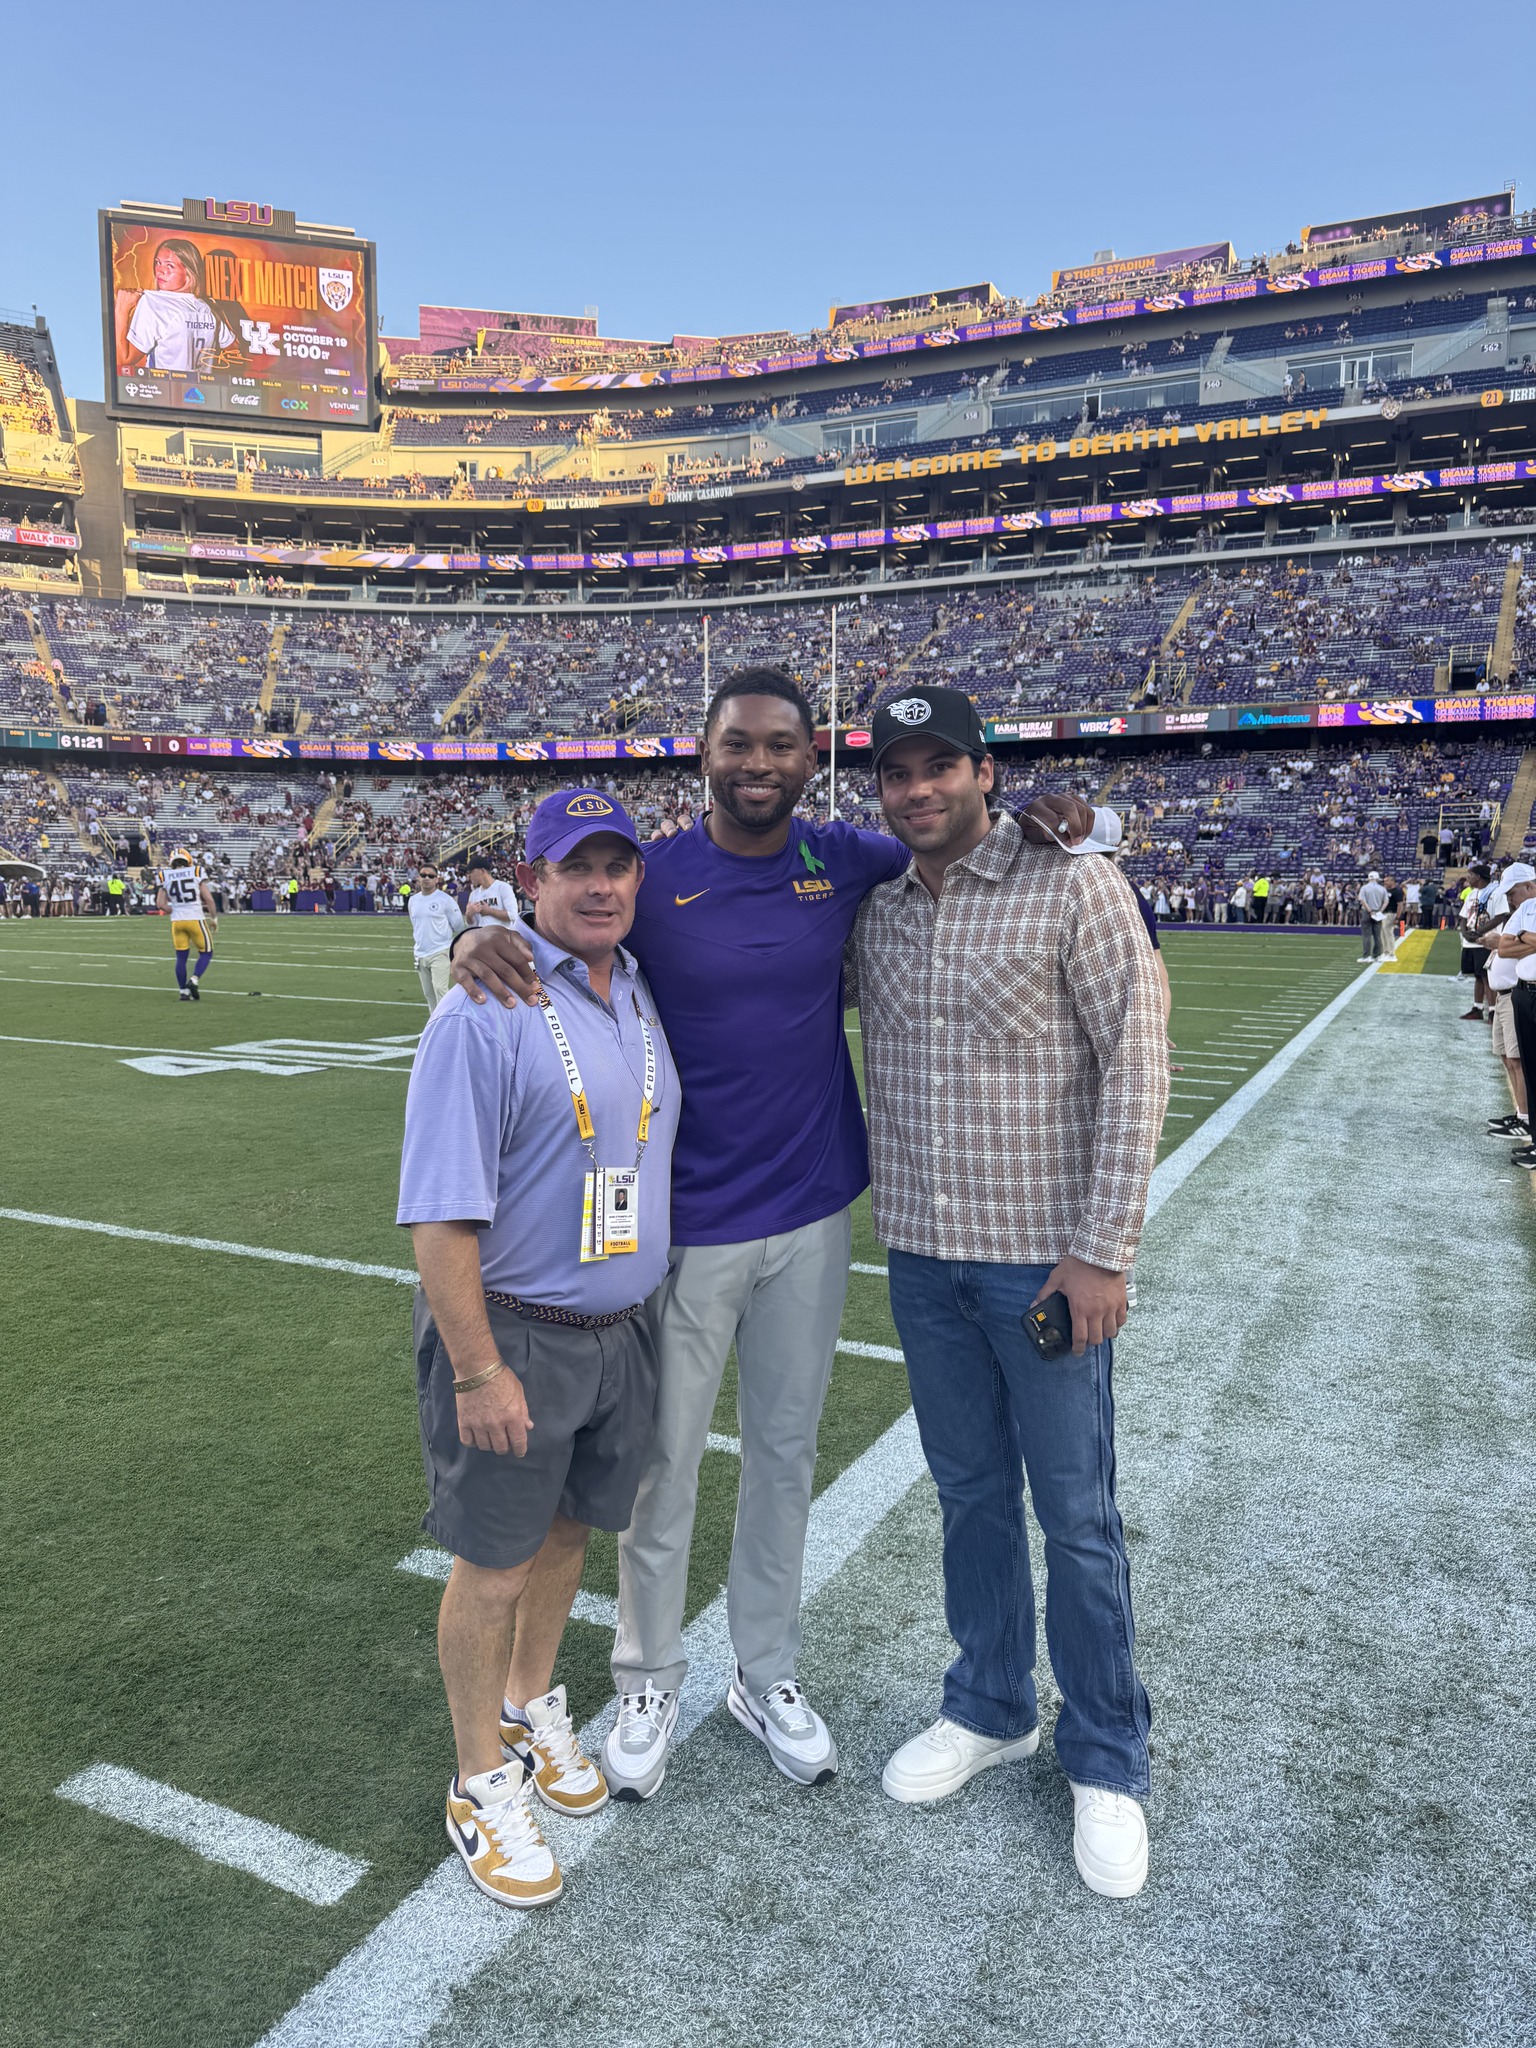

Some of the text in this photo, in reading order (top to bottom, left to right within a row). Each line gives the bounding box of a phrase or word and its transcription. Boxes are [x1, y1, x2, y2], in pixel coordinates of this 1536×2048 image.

[206, 197, 273, 226] LSU
[1450, 243, 1522, 260] GEAUX TIGERS
[1073, 267, 1104, 280] TIGER
[1106, 257, 1156, 275] STADIUM
[1318, 263, 1386, 281] GEAUX TIGERS
[327, 272, 344, 280] LSU
[204, 255, 318, 310] NEXT MATCH
[1193, 285, 1257, 300] GEAUX TIGERS
[1076, 304, 1136, 319] GEAUX TIGERS
[185, 320, 215, 330] TIGERS
[966, 321, 1022, 336] GEAUX TIGERS
[239, 319, 280, 356] UK
[283, 332, 347, 347] OCTOBER 19
[555, 337, 604, 347] TIGER STADIUM
[283, 343, 320, 359] 1:00
[864, 338, 916, 352] GEAUX TIGERS
[1483, 343, 1499, 352] 562
[768, 355, 817, 368] GEAUX TIGERS
[138, 368, 145, 376] 0
[696, 369, 721, 377] TIGERS
[400, 378, 435, 387] Equipment
[441, 381, 487, 390] LSU Online
[1206, 380, 1220, 389] 560
[342, 387, 348, 395] 0
[1486, 392, 1498, 404] 21
[281, 399, 309, 411] COX
[329, 402, 360, 411] VENTURE
[966, 412, 977, 420] 558
[844, 408, 1328, 486] WELCOME TO DEATH VALLEY
[652, 487, 734, 503] 37 TOMMY CASANOVA
[531, 498, 599, 510] 20 BILLY CANNON
[206, 548, 245, 557] TACO BELL
[1435, 696, 1535, 709] GEAUX TIGERS
[1180, 712, 1209, 724] BASF
[1257, 714, 1311, 725] Albertsons
[994, 721, 1053, 734] FARM BUREAU
[1080, 718, 1123, 734] WBRZ 2
[1019, 730, 1052, 739] INSURANCE
[61, 734, 103, 749] 61:21
[169, 739, 179, 752] 0
[299, 744, 370, 754] GEAUX TIGERS
[433, 746, 498, 755] GEAUX TIGERS
[556, 745, 617, 755] GEAUX TIGERS
[577, 801, 603, 811] LSU
[170, 879, 197, 903] 45
[792, 879, 832, 894] LSU
[798, 892, 834, 901] TIGERS
[548, 1015, 578, 1085] FOOTBALL
[644, 1027, 655, 1091] FOOTBALL
[577, 1099, 586, 1116] LSU
[616, 1175, 635, 1184] LSU
